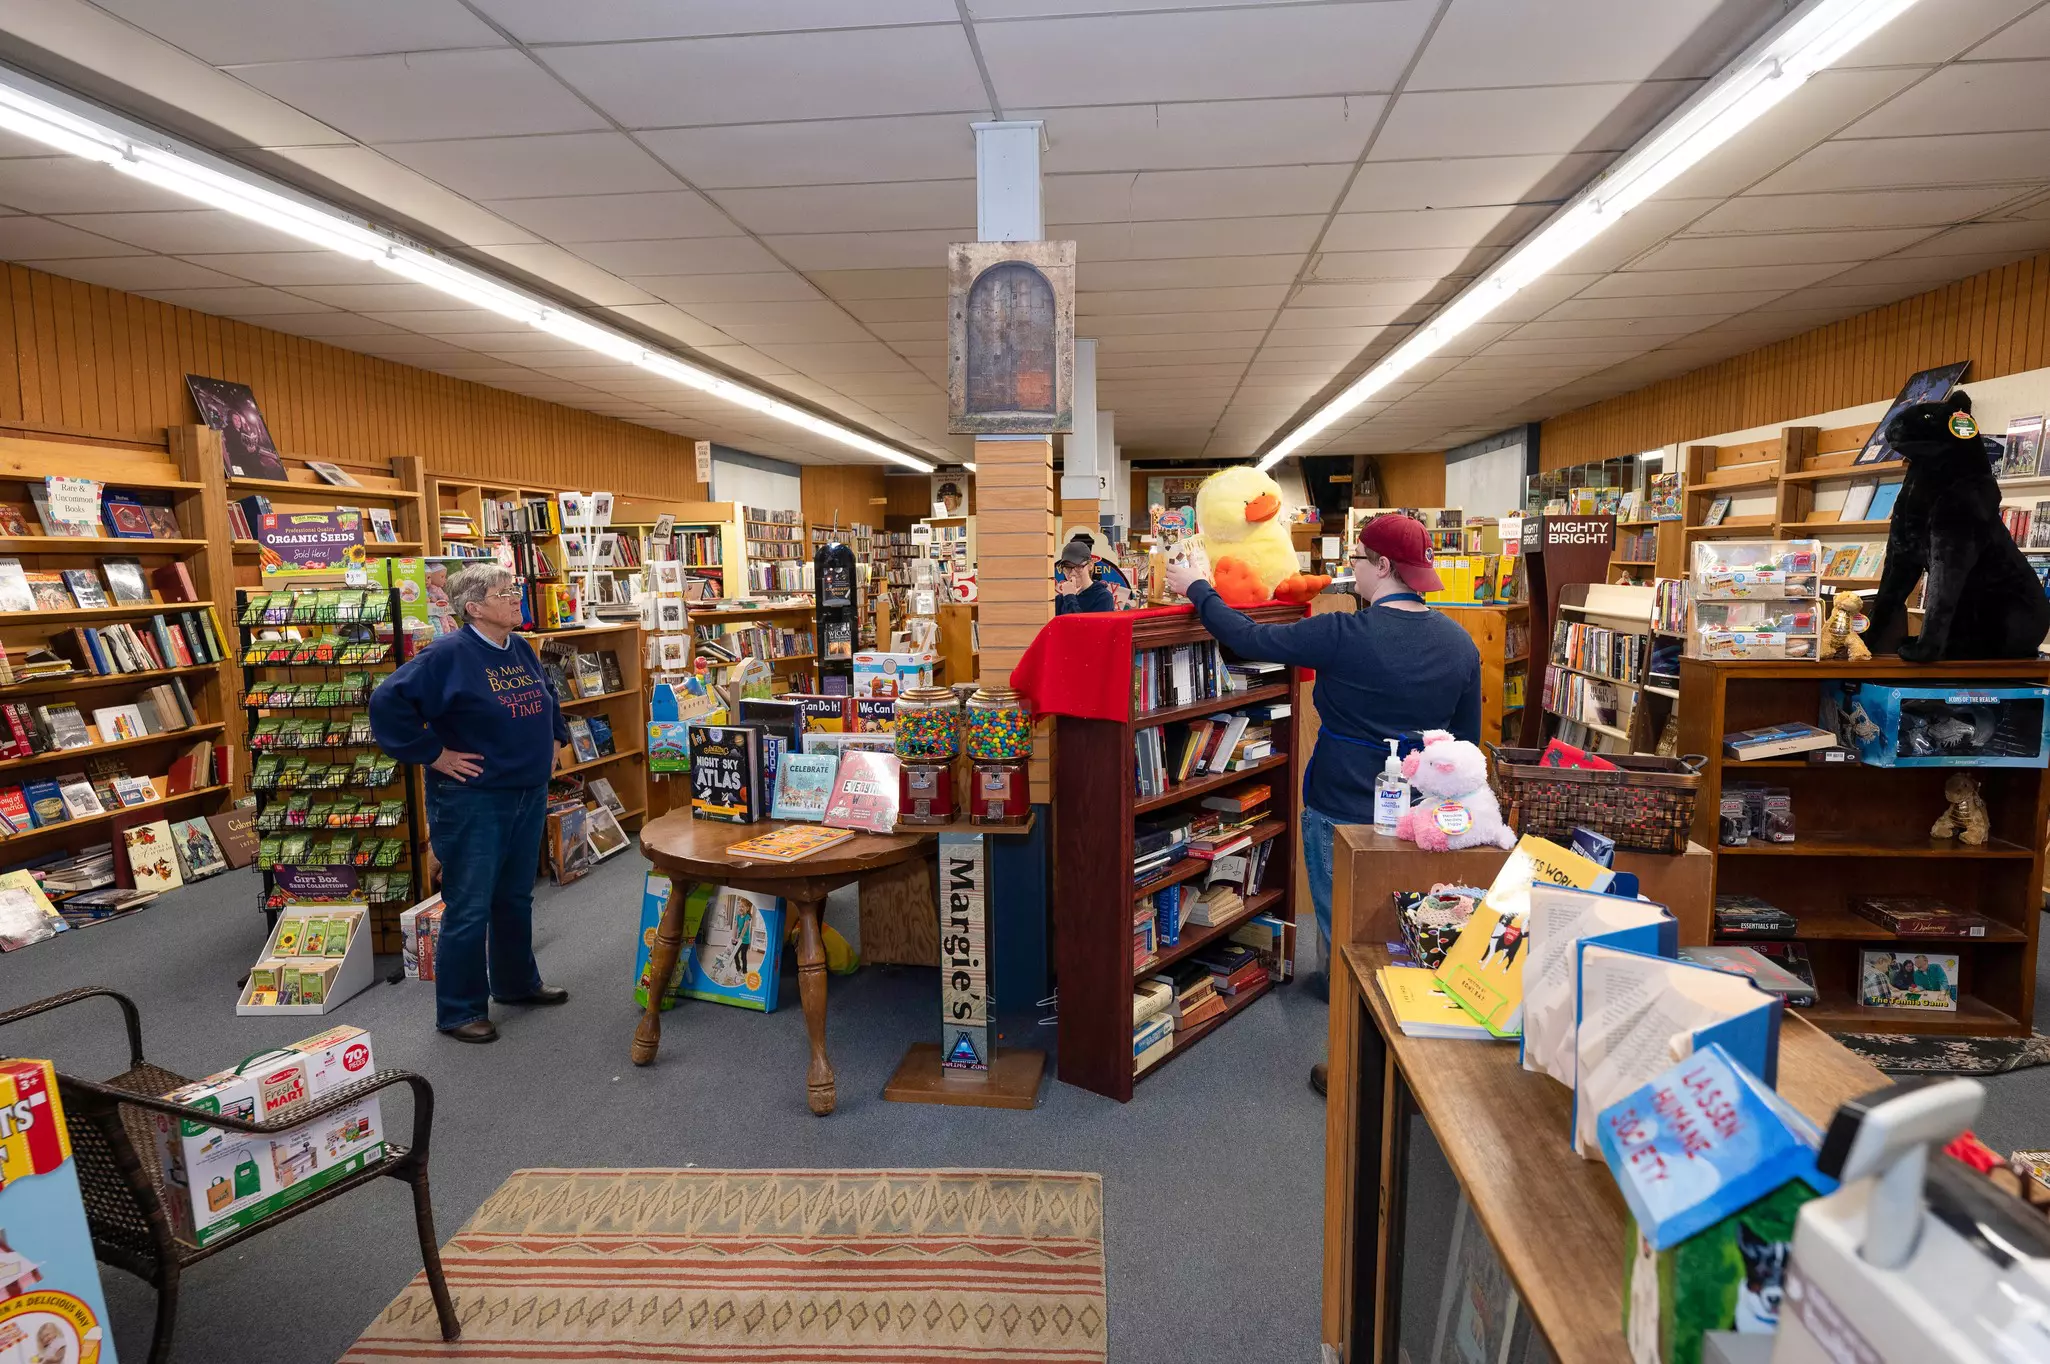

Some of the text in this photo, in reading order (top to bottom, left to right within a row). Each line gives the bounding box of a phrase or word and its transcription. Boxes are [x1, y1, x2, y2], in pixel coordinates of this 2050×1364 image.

[61, 483, 86, 492] Rare &
[55, 493, 94, 503] Uncommon
[64, 504, 86, 513] Books
[1523, 523, 1539, 534] MIGHTY
[1549, 522, 1609, 533] MIGHTY
[1523, 534, 1539, 545] BRIGHT
[1548, 533, 1608, 544] BRIGHT.
[293, 547, 331, 560] Sold Here!
[512, 688, 543, 703] LITTLE
[507, 700, 543, 718] TIME
[819, 700, 831, 712] Do
[832, 701, 841, 712] It!
[859, 702, 892, 714] We Can
[696, 756, 720, 768] NIGHT
[722, 758, 739, 770] SKY
[789, 765, 829, 773] CELEBRATE
[696, 767, 741, 790] ATLAS
[1382, 791, 1401, 799] Purell
[317, 875, 339, 883] BOX
[944, 856, 980, 1020] Margie's
[1872, 995, 1949, 1008] The Tennis Game
[345, 1048, 368, 1064] 70+
[348, 1057, 366, 1070] PIECES
[20, 1077, 39, 1091] 3+
[264, 1082, 295, 1102] Fresh
[266, 1087, 304, 1112] MART
[1682, 1066, 1742, 1140] LASSEN
[1610, 1109, 1670, 1184] SOCIETY
[15, 1300, 23, 1309] A
[26, 1295, 76, 1313] DELICIOUS
[74, 1308, 90, 1327] WAY
